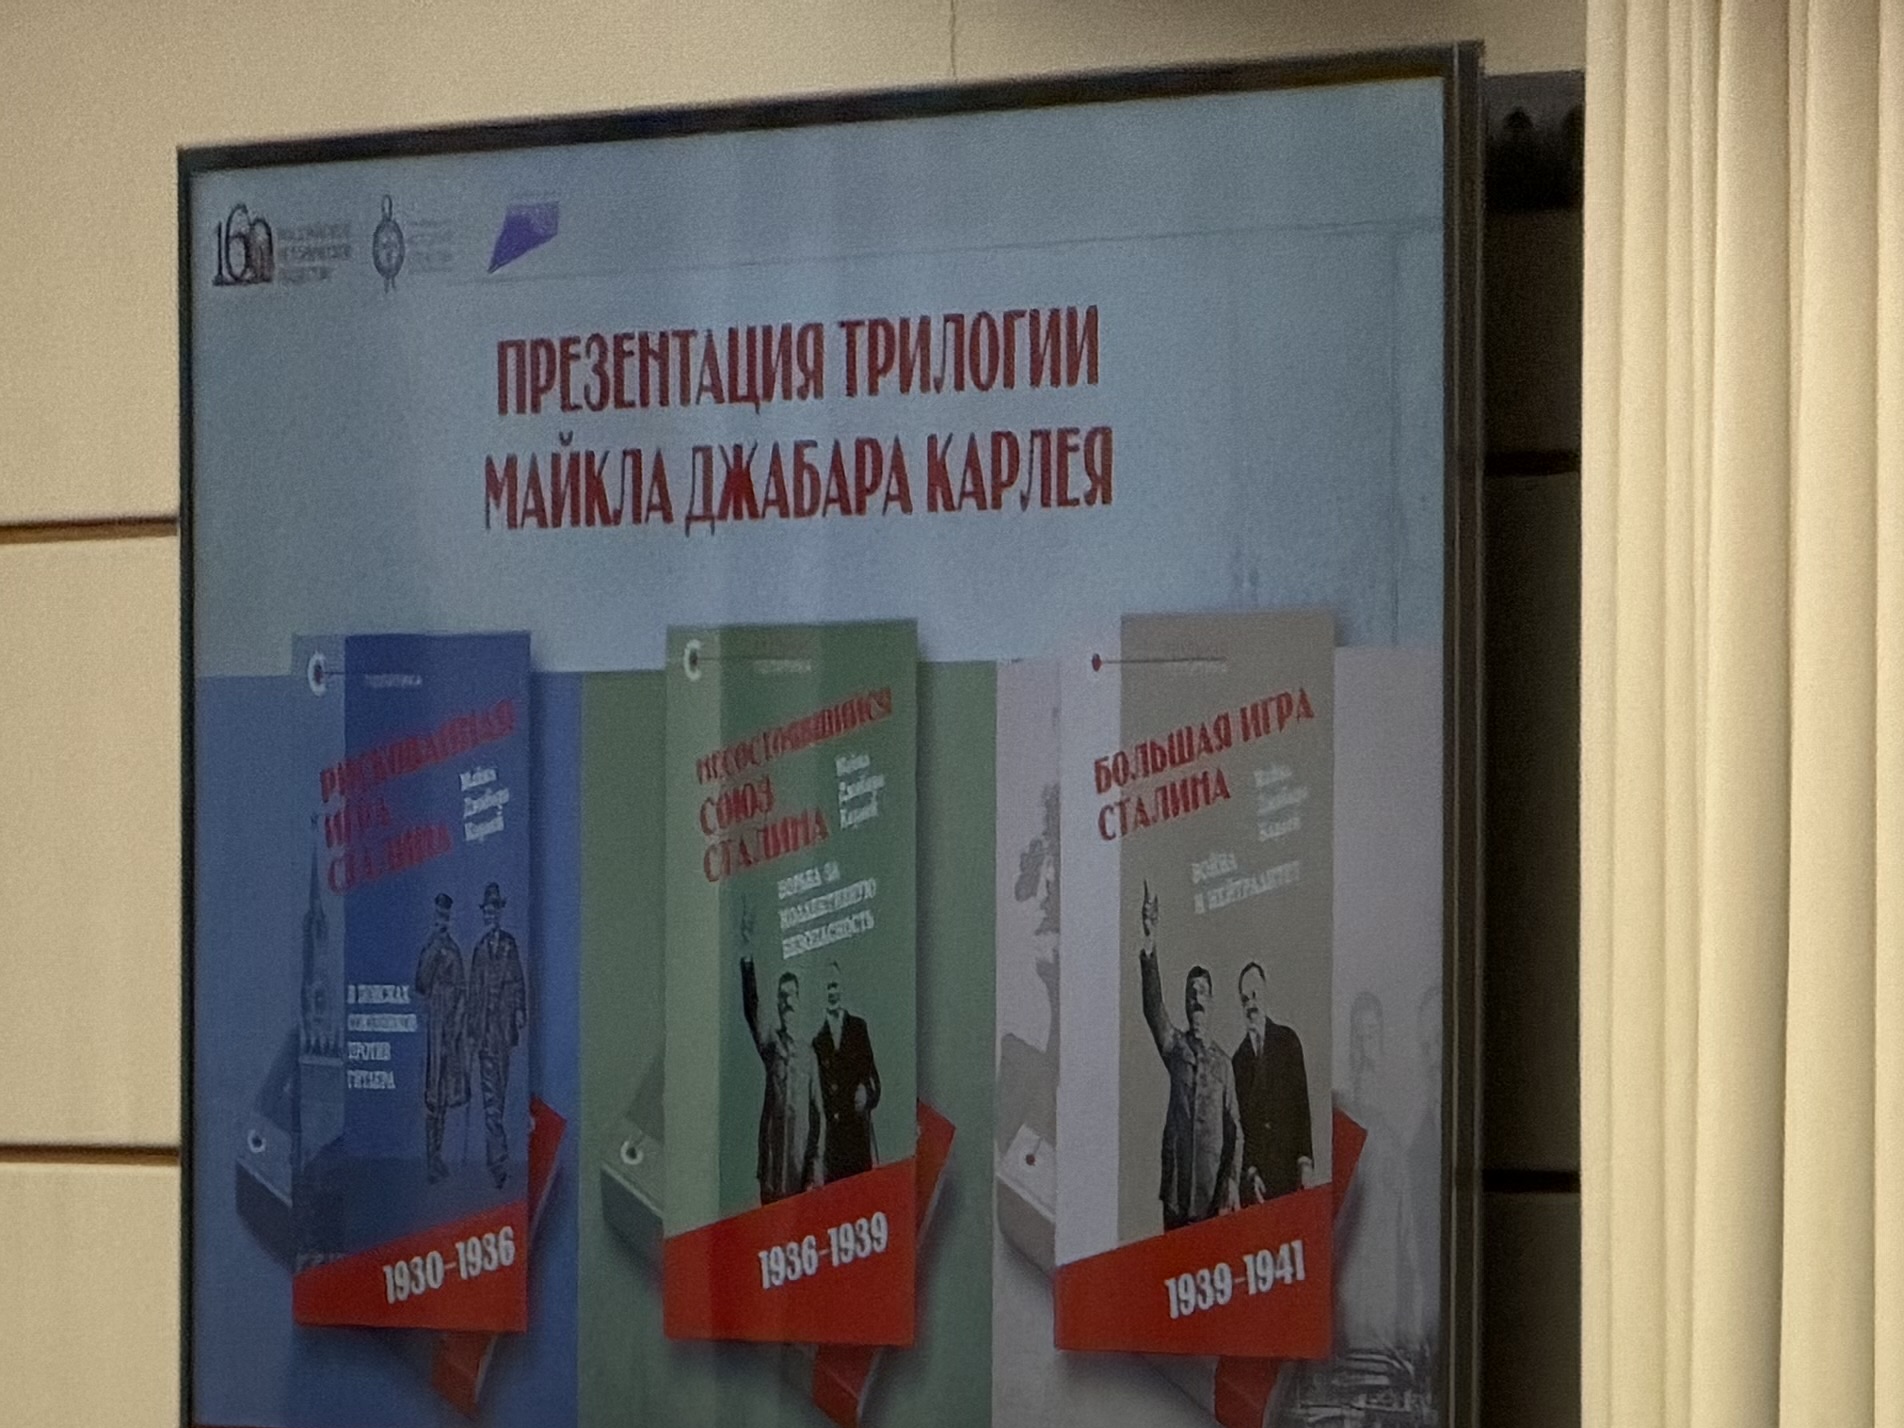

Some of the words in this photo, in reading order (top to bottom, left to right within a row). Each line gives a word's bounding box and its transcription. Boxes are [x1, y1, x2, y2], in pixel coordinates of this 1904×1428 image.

[497, 322, 825, 417] ПРЕЗЕНТАЦИЯ
[838, 304, 1099, 398] ТРИЛОГИИ
[484, 430, 674, 531] МАЙКЛА
[684, 433, 914, 537] ДЖАБАРА
[925, 425, 1114, 513] КАРЛЕЯ
[1094, 711, 1233, 795] БОЛЬШАЯ
[1240, 687, 1315, 743] ИГРА
[1098, 767, 1231, 842] СТАЛИНА
